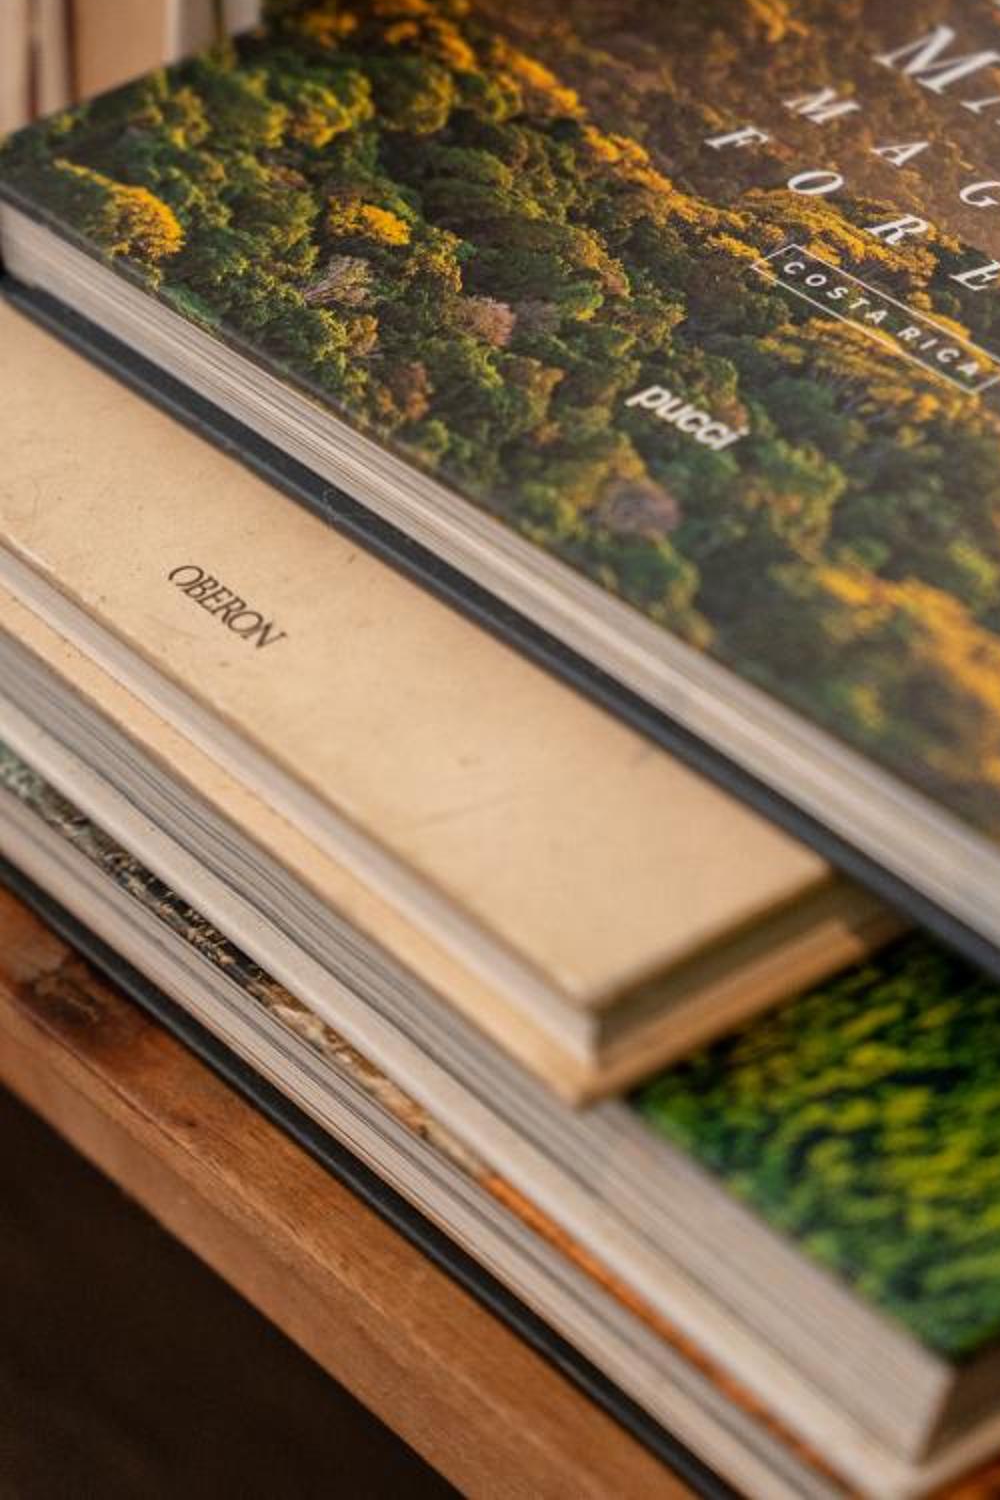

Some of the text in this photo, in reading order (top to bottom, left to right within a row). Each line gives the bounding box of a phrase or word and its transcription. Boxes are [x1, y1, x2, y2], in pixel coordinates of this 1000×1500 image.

[783, 260, 984, 379] COSTA RICA
[624, 384, 750, 451] pucci
[167, 564, 288, 649] OBERON
